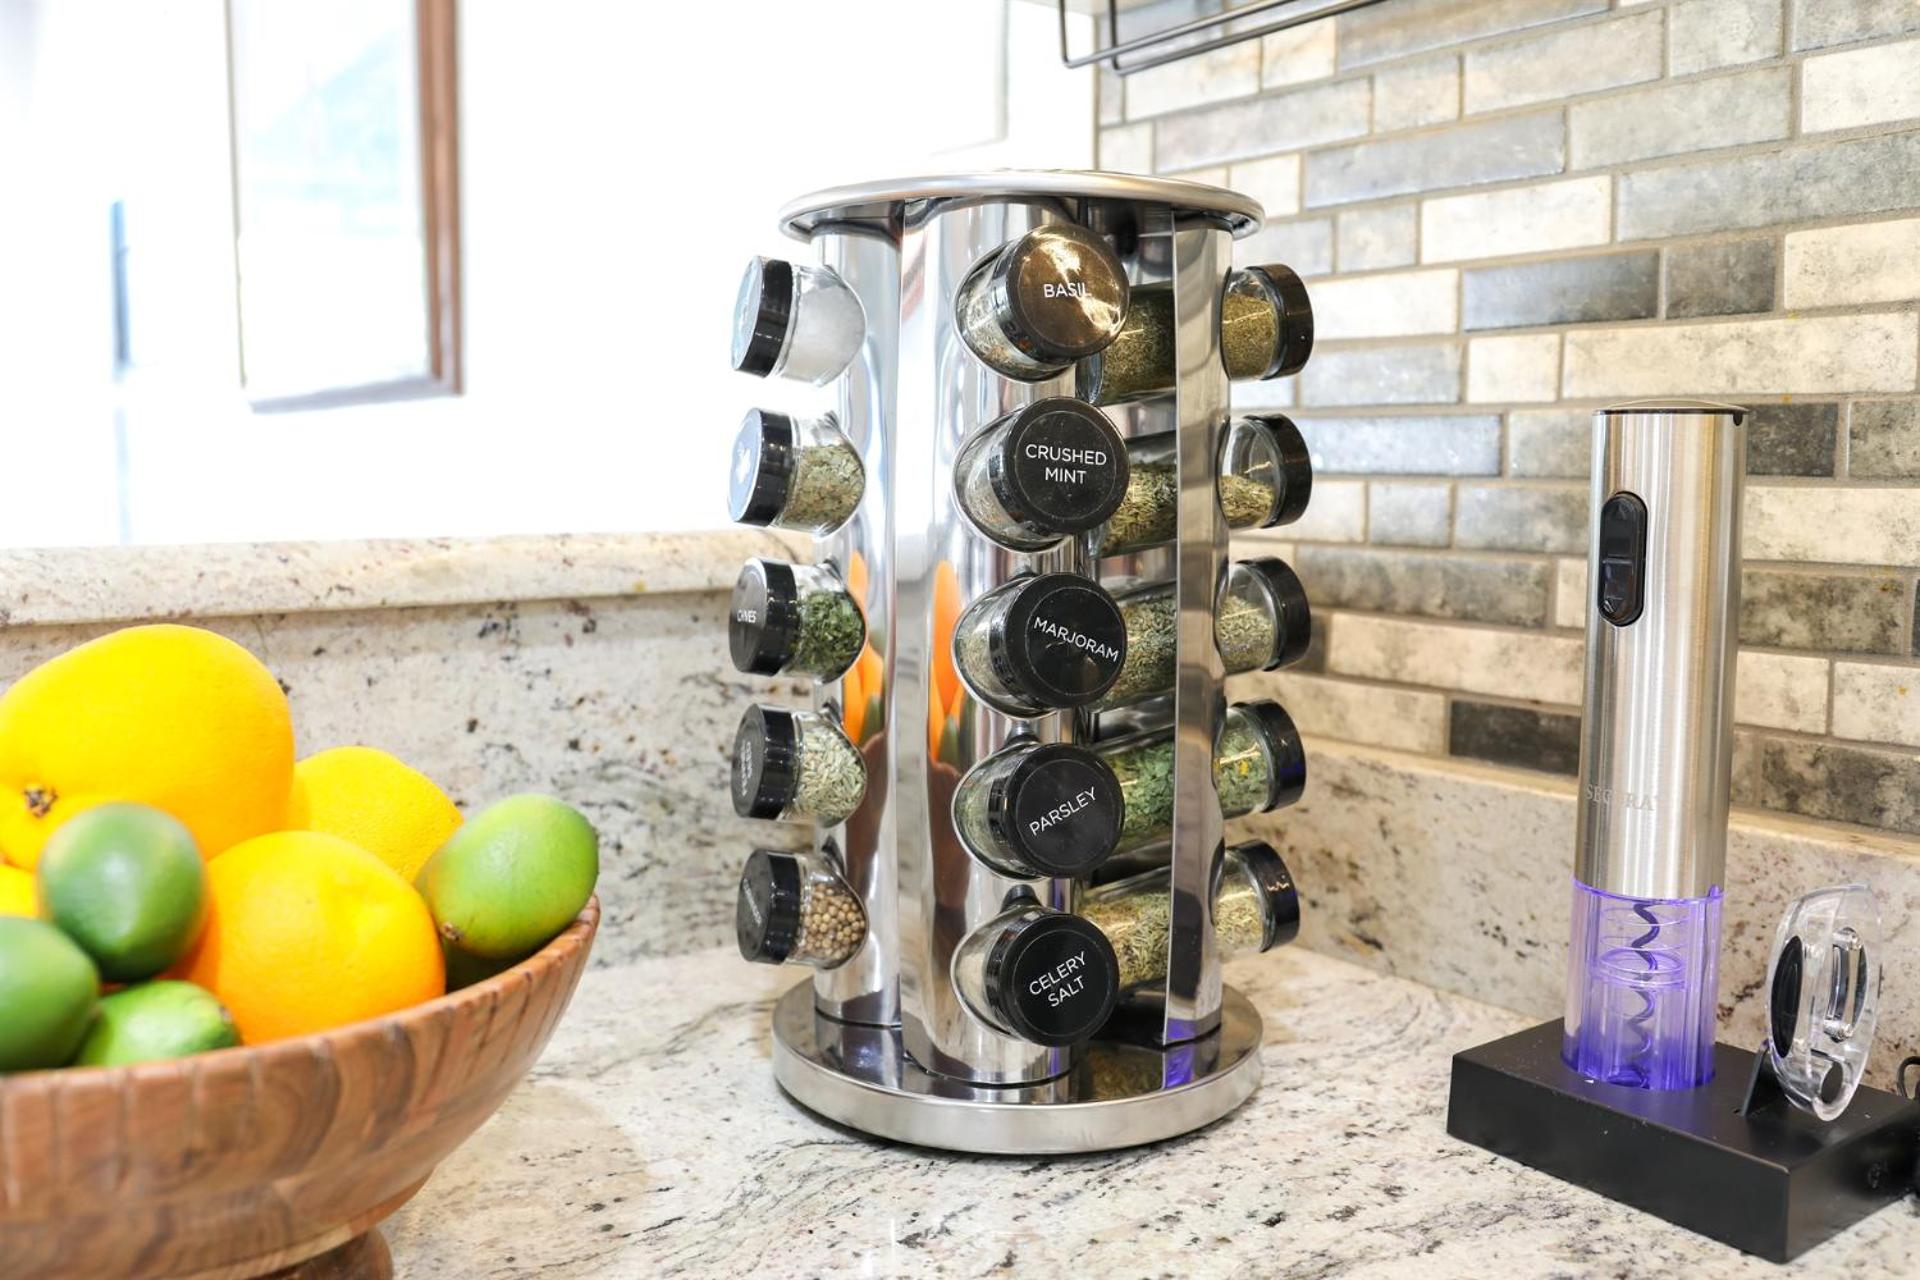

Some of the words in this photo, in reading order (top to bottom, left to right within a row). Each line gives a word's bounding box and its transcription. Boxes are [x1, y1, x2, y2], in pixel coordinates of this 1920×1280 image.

[1043, 282, 1092, 298] BASIL
[1025, 443, 1107, 466] CRUSHED
[1045, 467, 1087, 484] MINT
[1034, 616, 1119, 662] MARJORAM
[1029, 787, 1097, 836] PARSLEY
[1029, 951, 1087, 995] CELERY
[1047, 975, 1086, 1007] SALT
